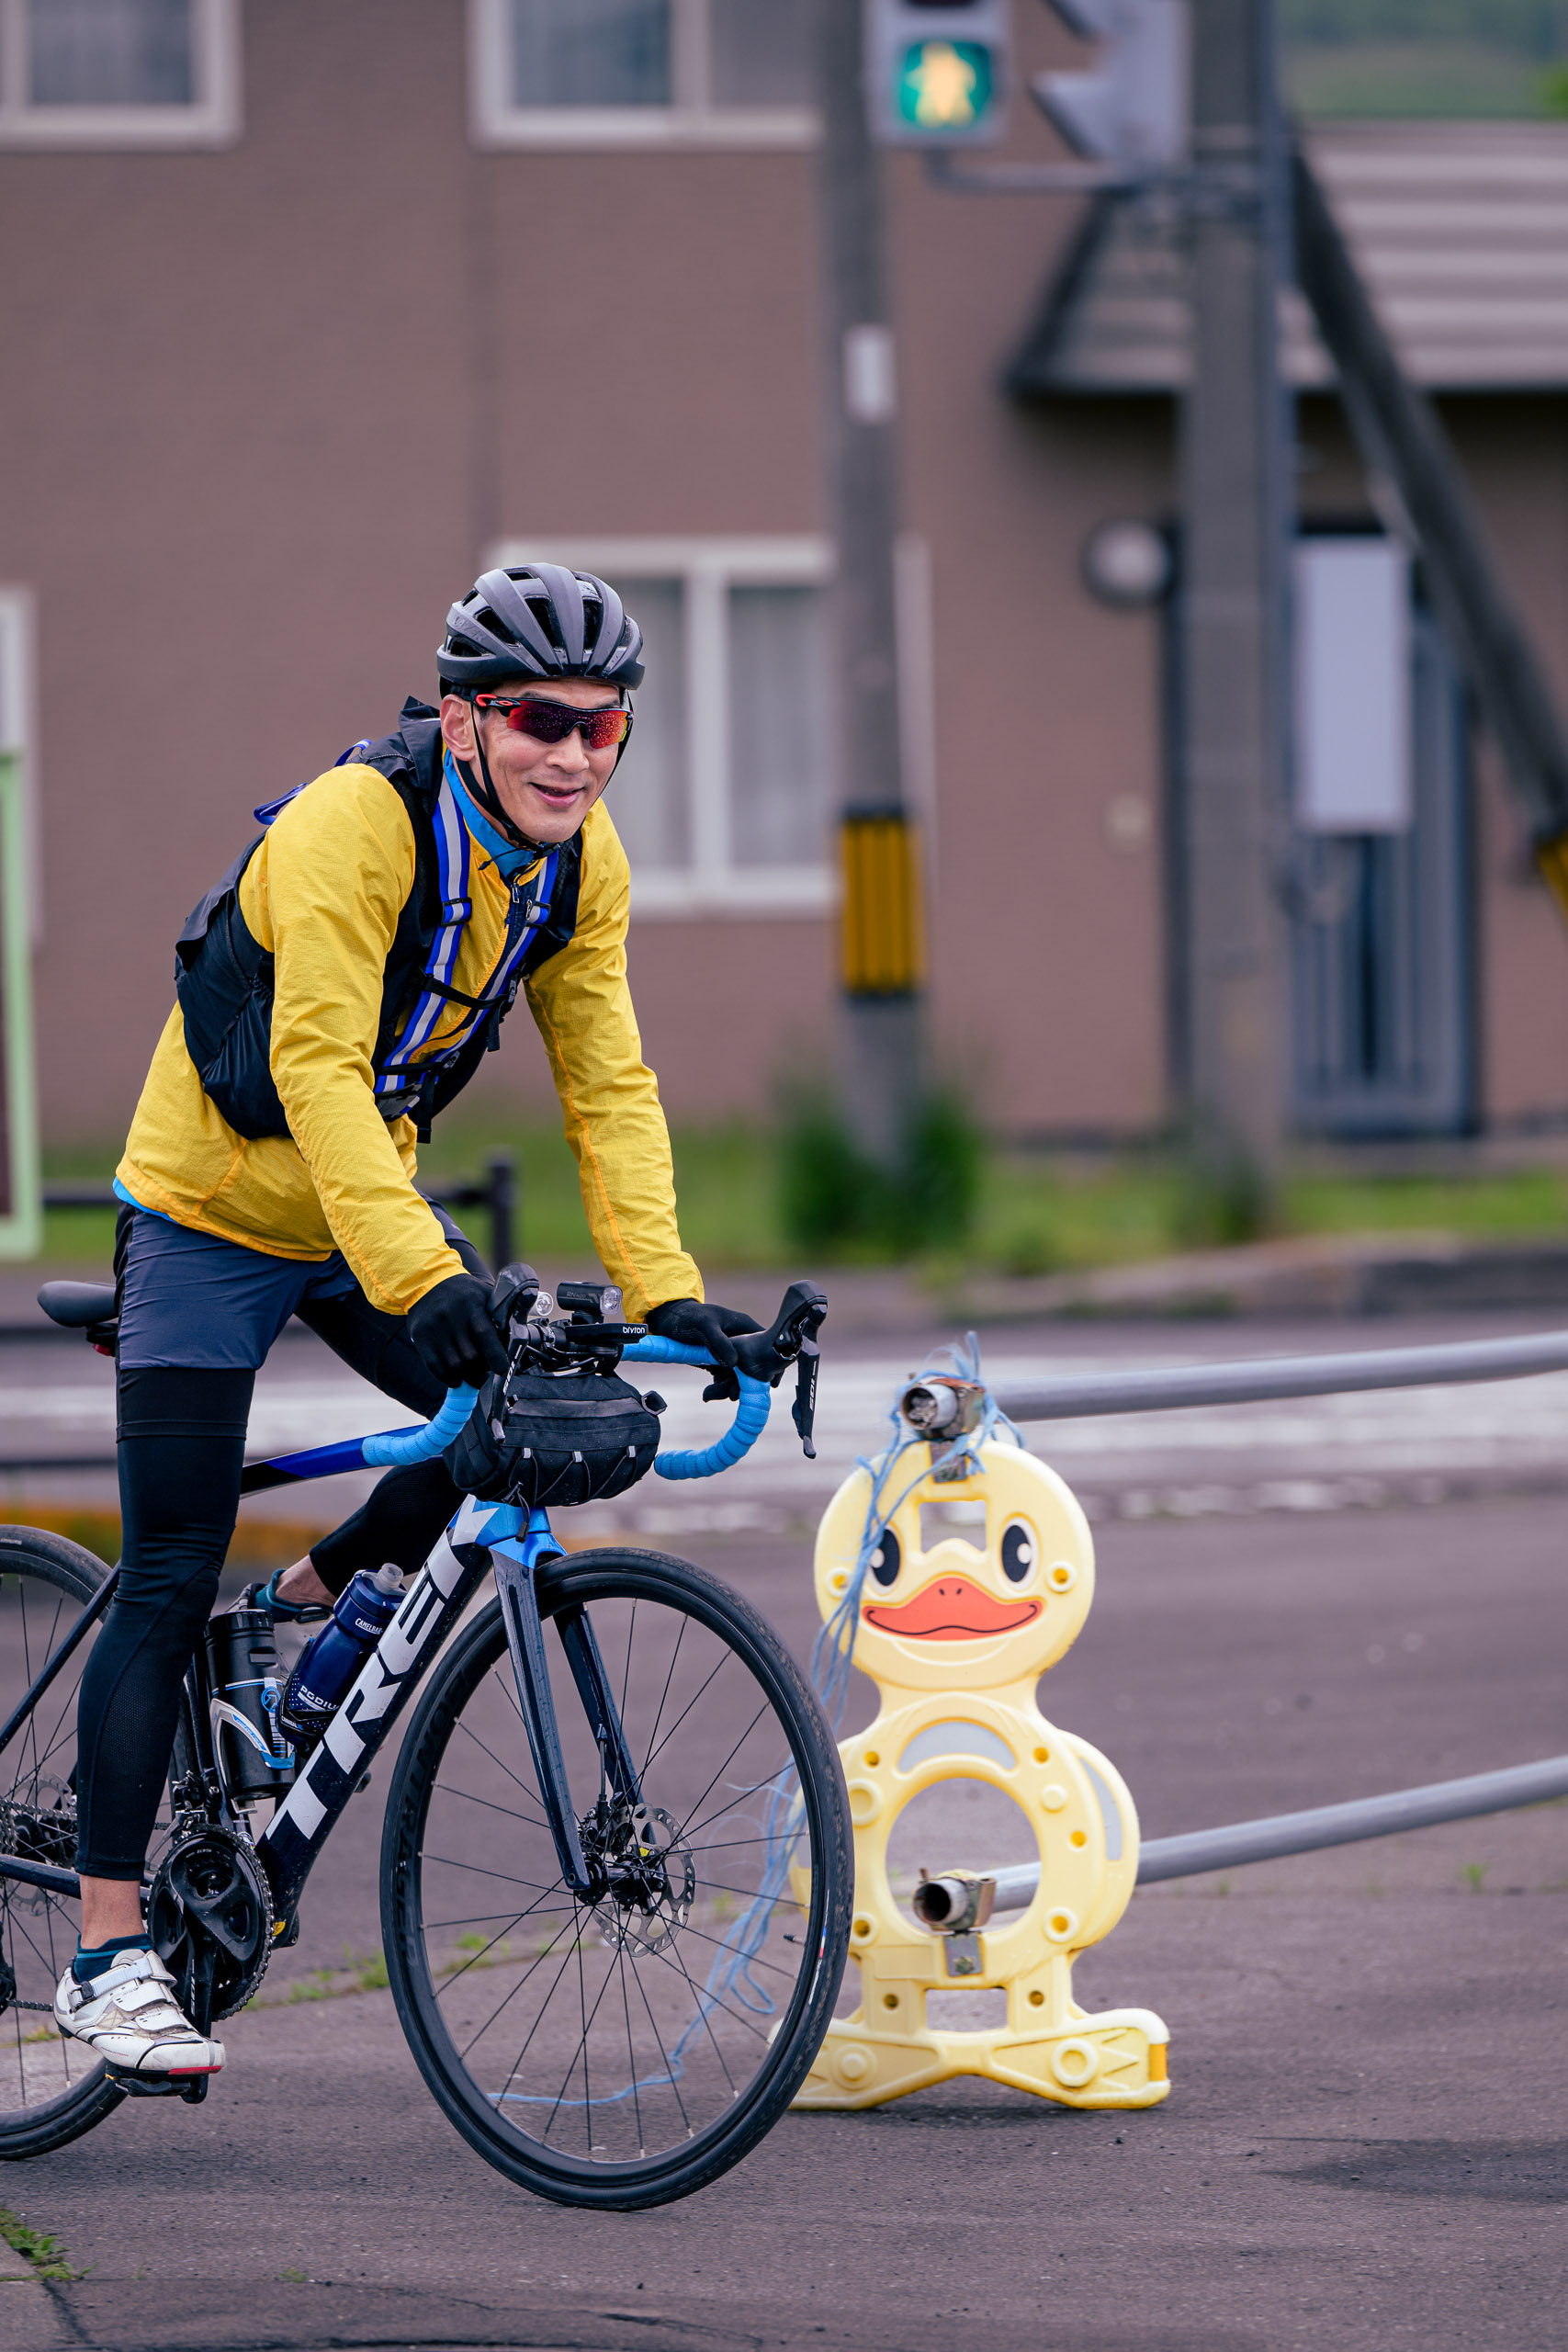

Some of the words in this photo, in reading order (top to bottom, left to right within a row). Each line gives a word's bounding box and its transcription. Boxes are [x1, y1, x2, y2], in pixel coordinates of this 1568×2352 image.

[622, 1326, 646, 1334] bryton
[265, 1493, 500, 1839] TREK
[299, 1684, 340, 1710] PODIU
